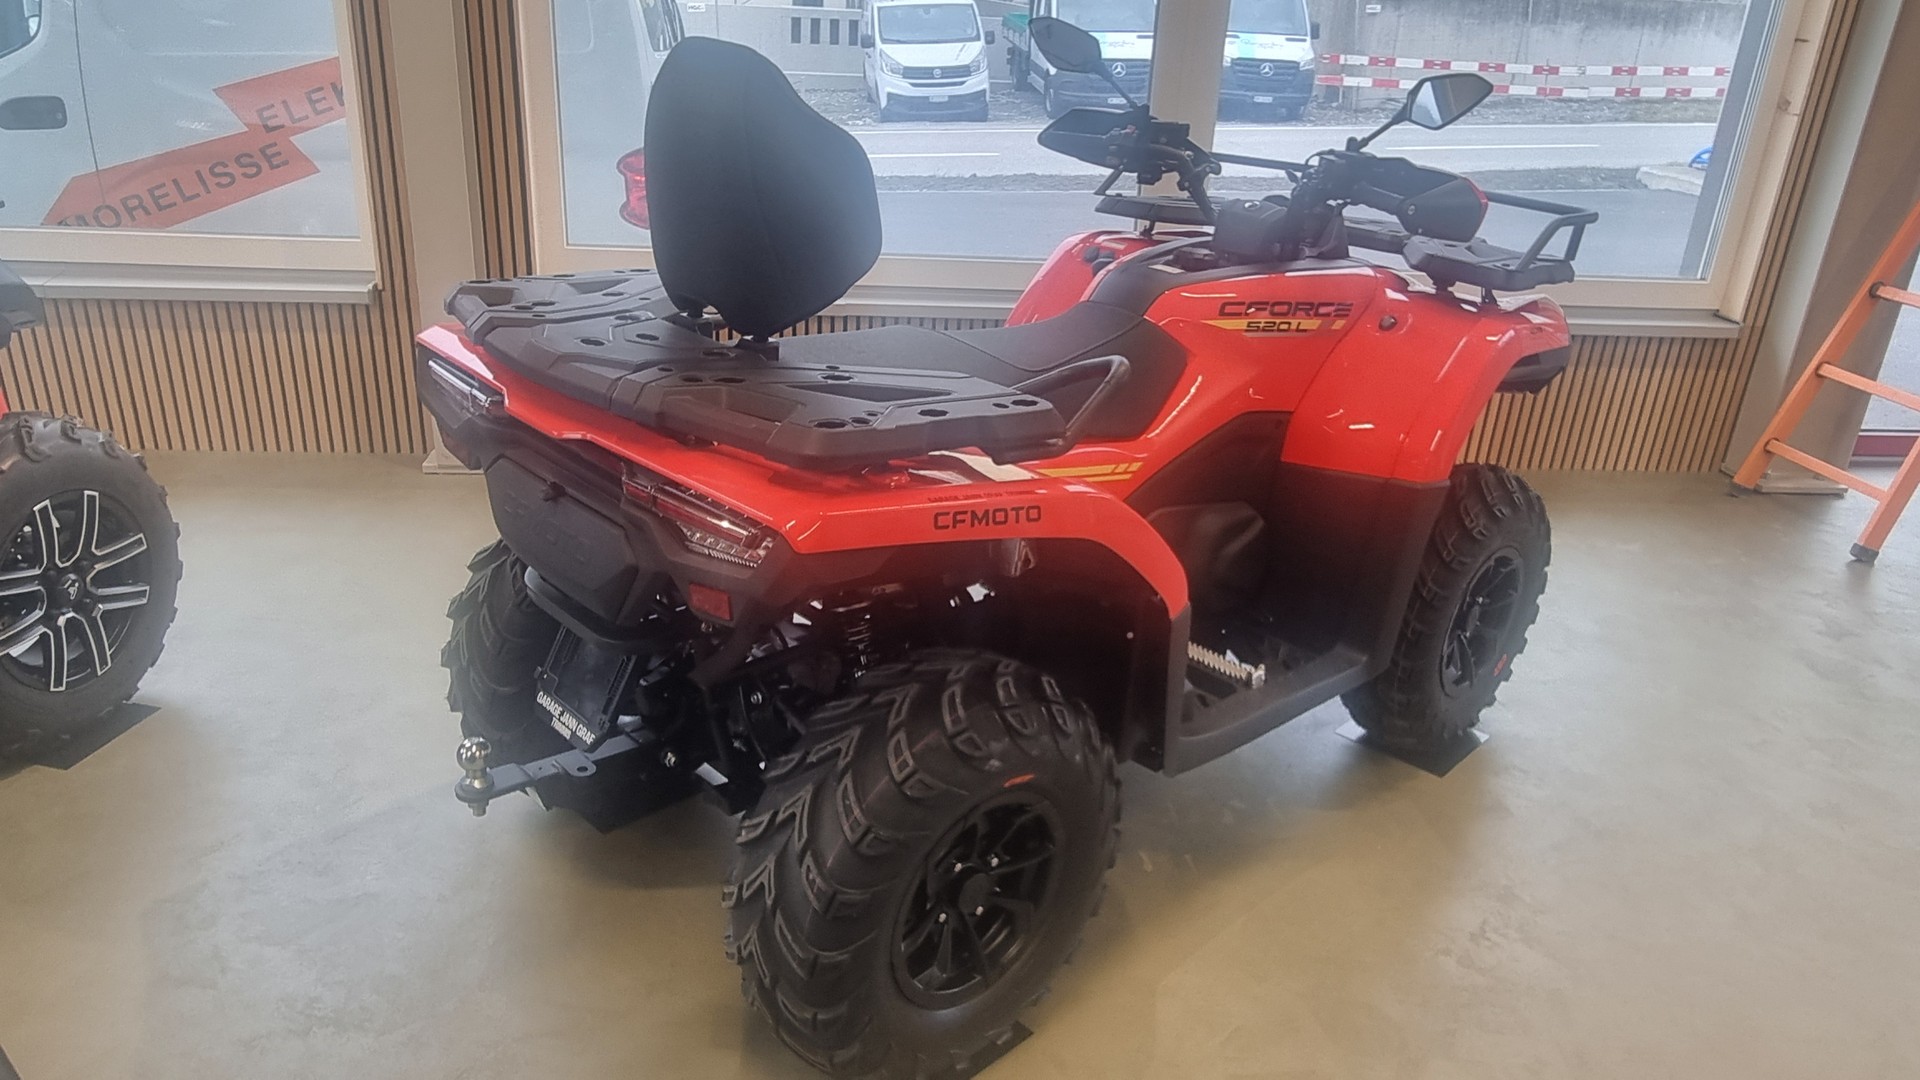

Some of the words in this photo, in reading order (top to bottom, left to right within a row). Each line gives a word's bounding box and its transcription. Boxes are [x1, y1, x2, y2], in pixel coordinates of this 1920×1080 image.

[1218, 301, 1354, 317] CFORCE
[1244, 321, 1291, 333] 520
[1297, 321, 1308, 333] L
[933, 505, 1042, 530] CFMOTO
[536, 691, 563, 719] GARAGE
[560, 711, 579, 733] JANN
[575, 723, 596, 746] GRAF
